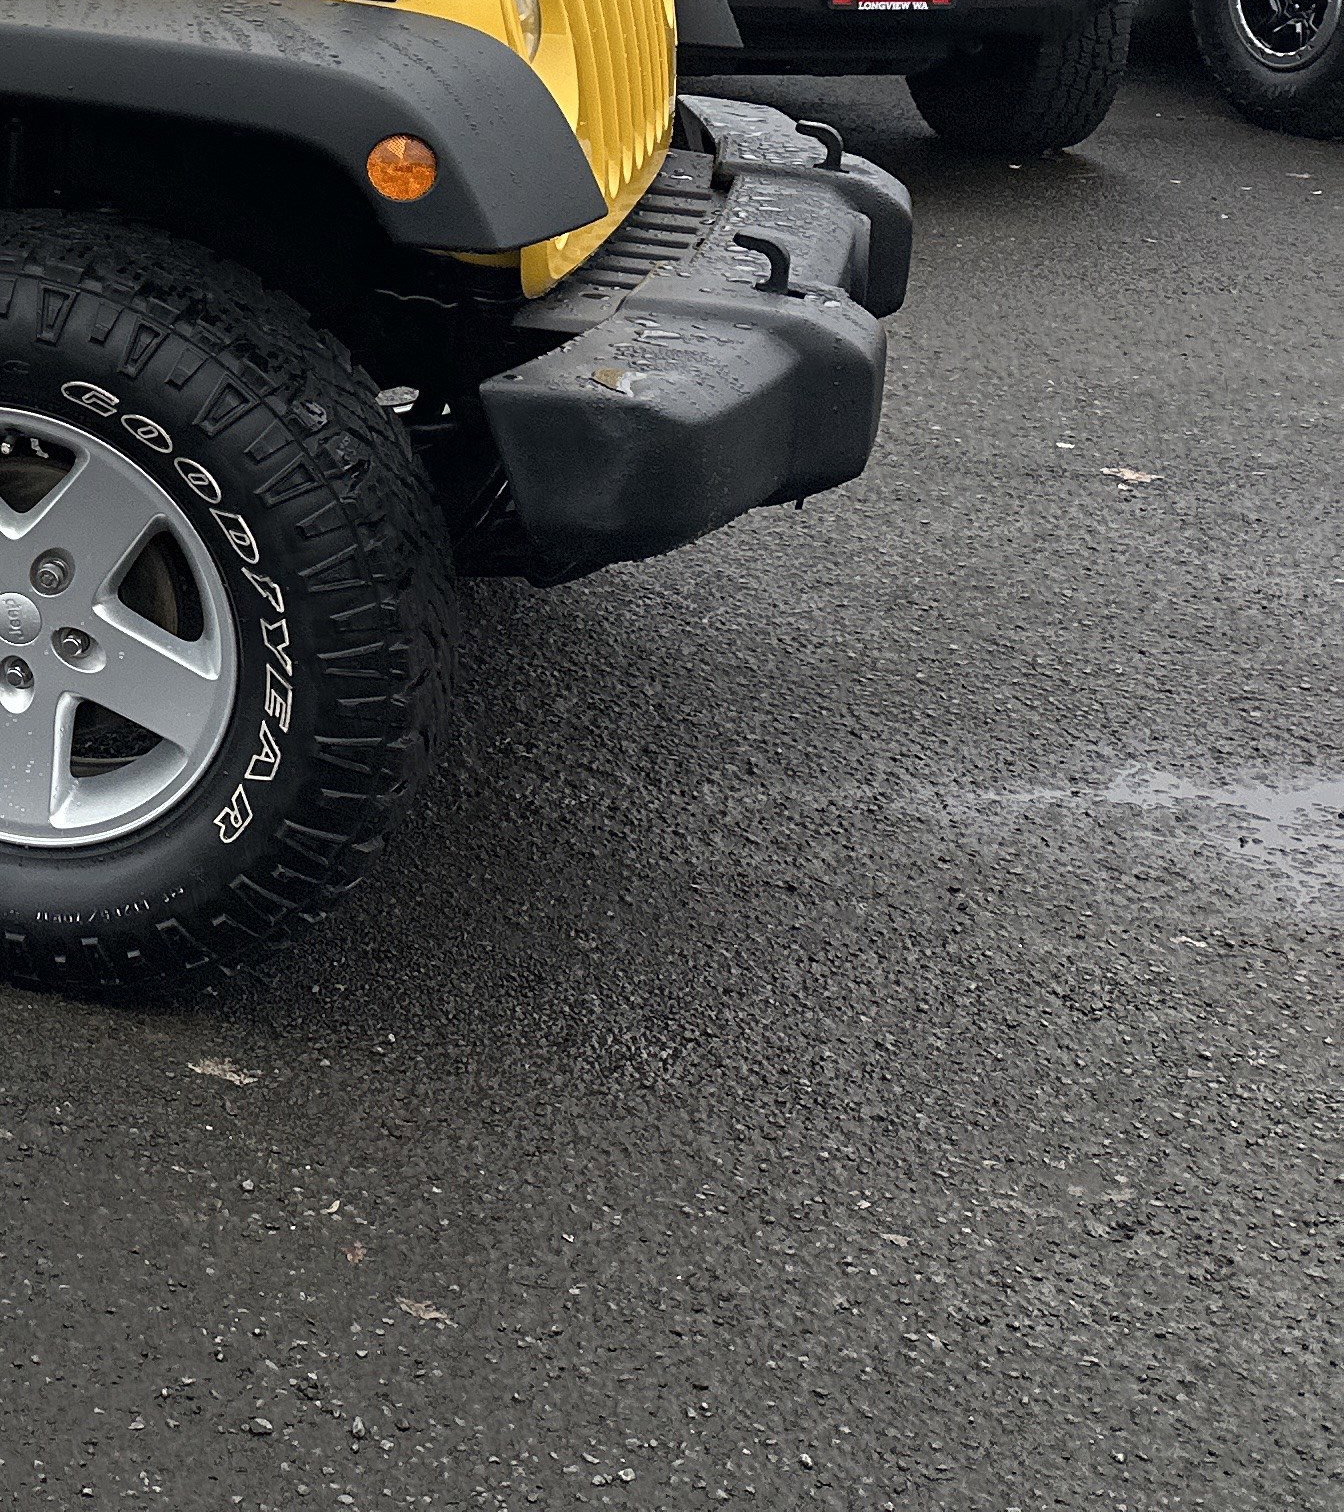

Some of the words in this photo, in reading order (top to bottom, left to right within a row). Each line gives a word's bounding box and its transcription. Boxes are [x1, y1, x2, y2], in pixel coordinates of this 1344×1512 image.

[858, 1, 910, 10] LONGVIEW
[912, 1, 929, 10] WA
[5, 598, 24, 639] Jeep
[60, 381, 294, 844] GOODYEAR
